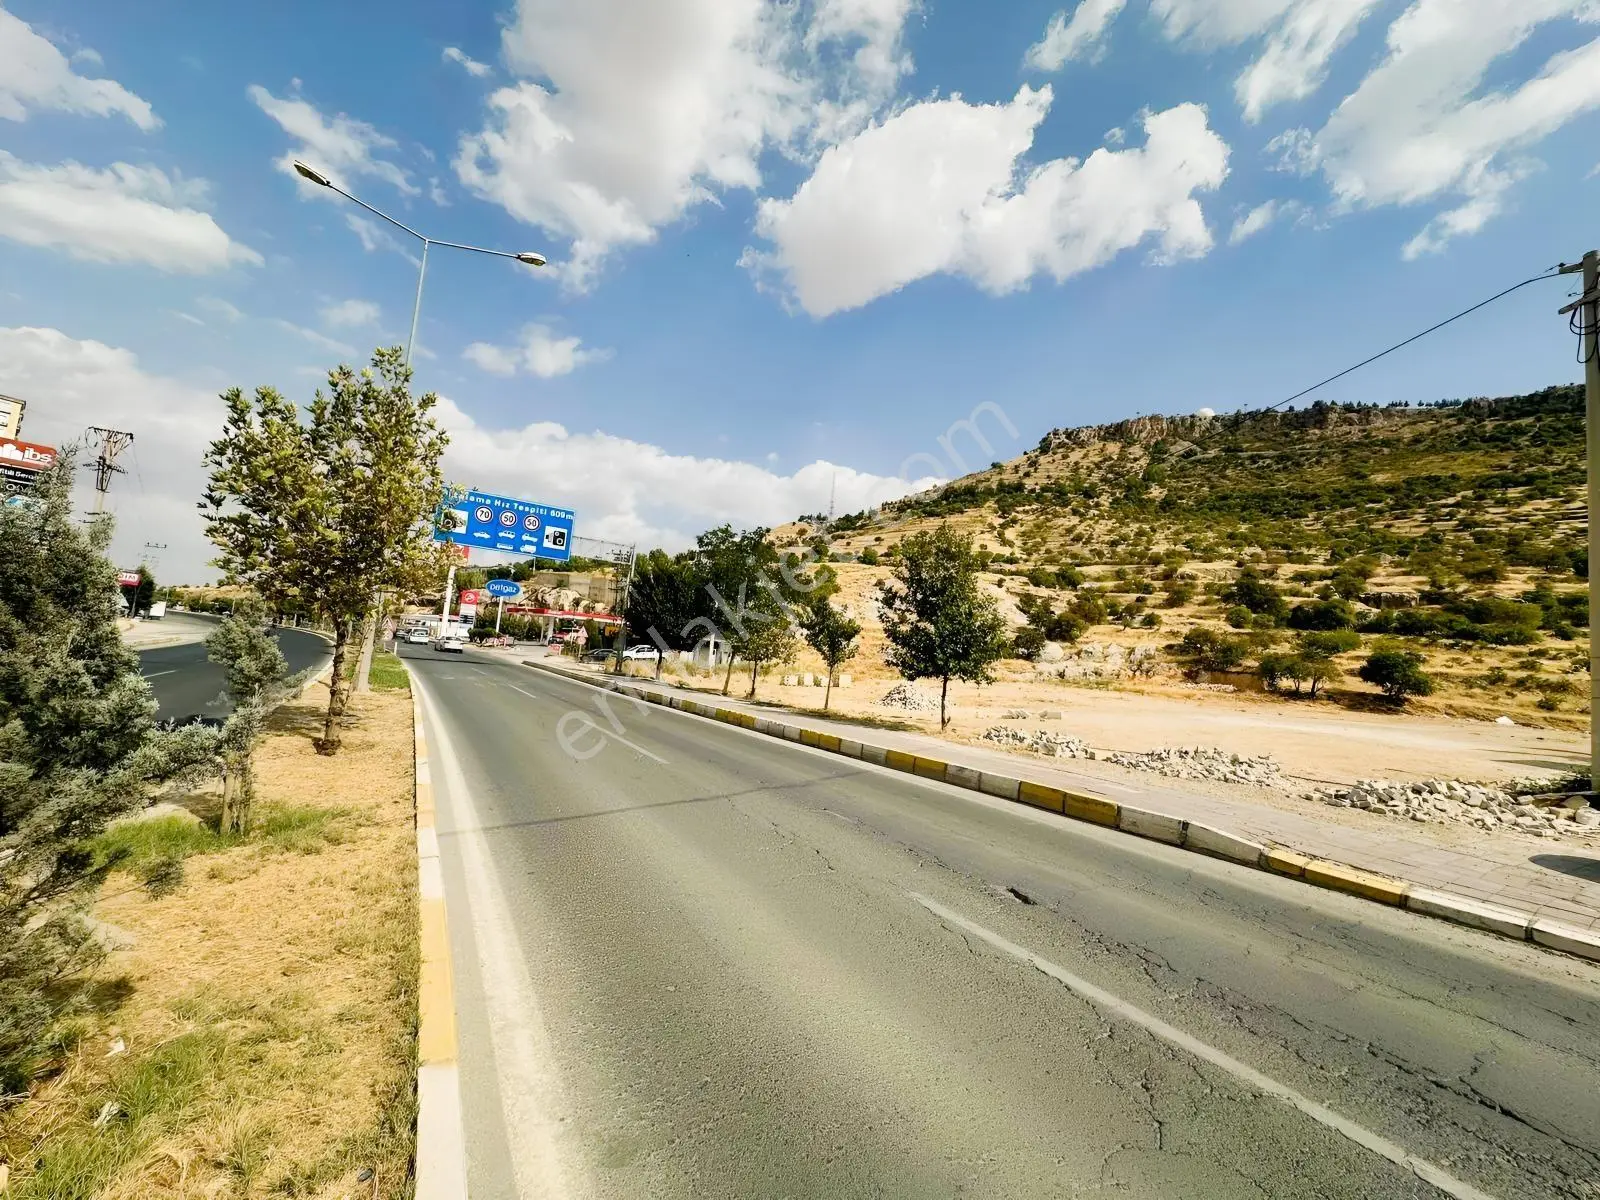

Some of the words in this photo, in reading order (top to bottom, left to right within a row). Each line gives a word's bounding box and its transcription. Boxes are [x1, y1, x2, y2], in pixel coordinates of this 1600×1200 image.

[513, 502, 547, 515] Tespiti
[479, 509, 490, 519] 70
[503, 514, 514, 523] 50
[526, 518, 537, 527] 50
